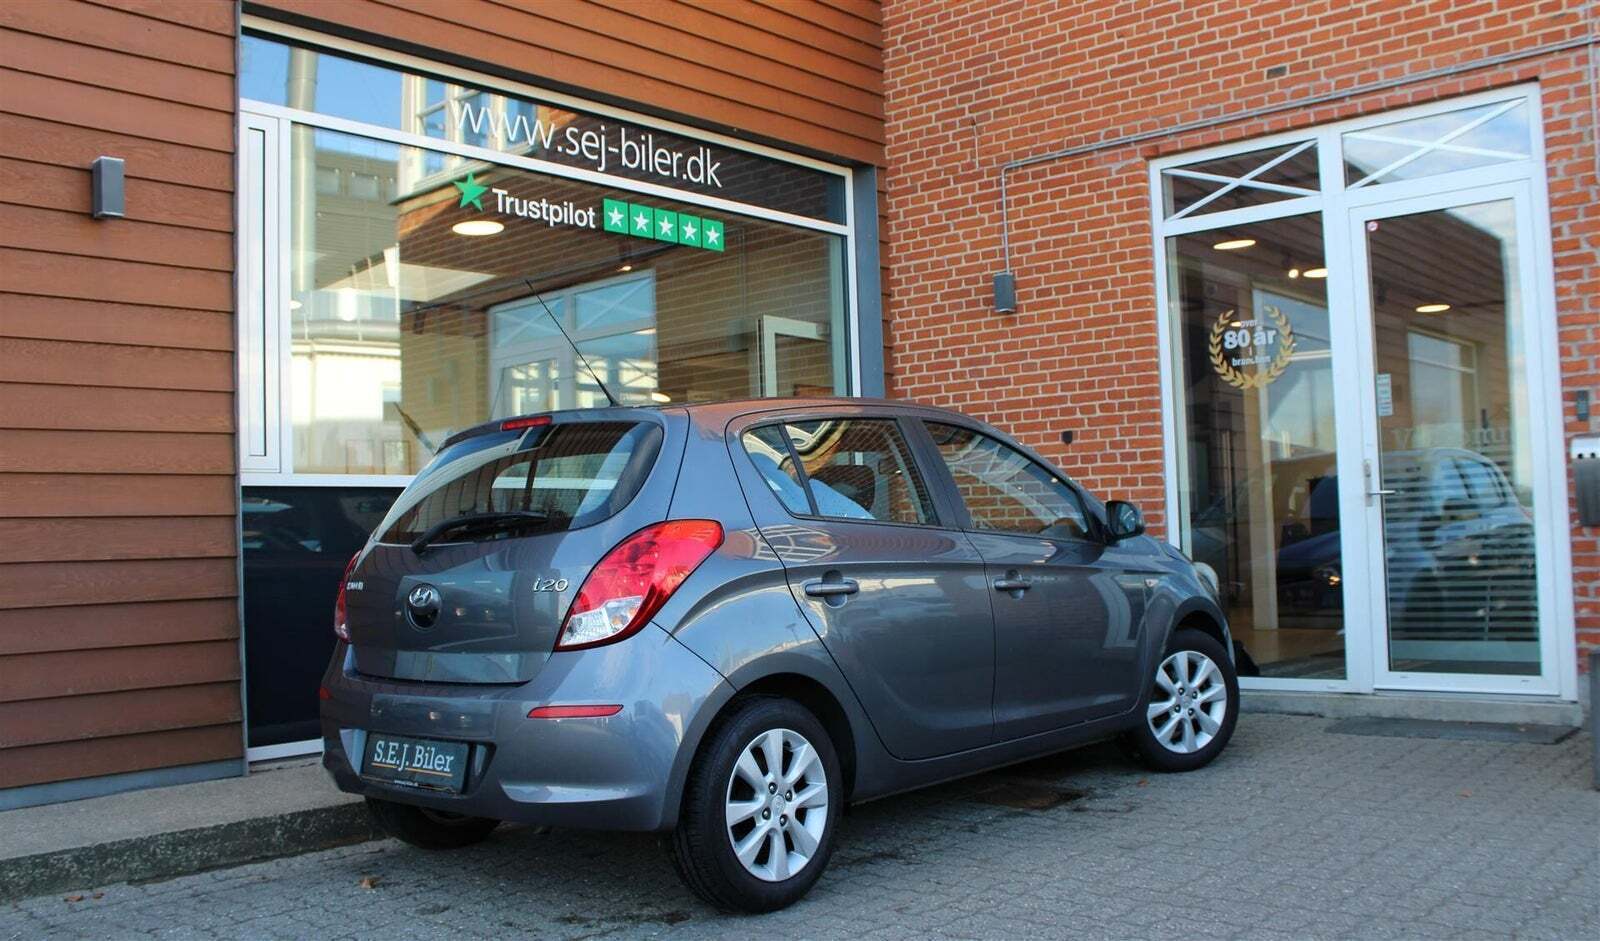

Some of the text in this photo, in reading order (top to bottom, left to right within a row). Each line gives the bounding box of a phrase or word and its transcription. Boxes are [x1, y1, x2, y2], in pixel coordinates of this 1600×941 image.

[448, 98, 723, 189] www.sej-biler.dk
[491, 187, 596, 229] Trustpilot
[1224, 326, 1276, 349] 80 år
[533, 577, 569, 593] i20
[373, 740, 455, 772] S.E.J. Biler
